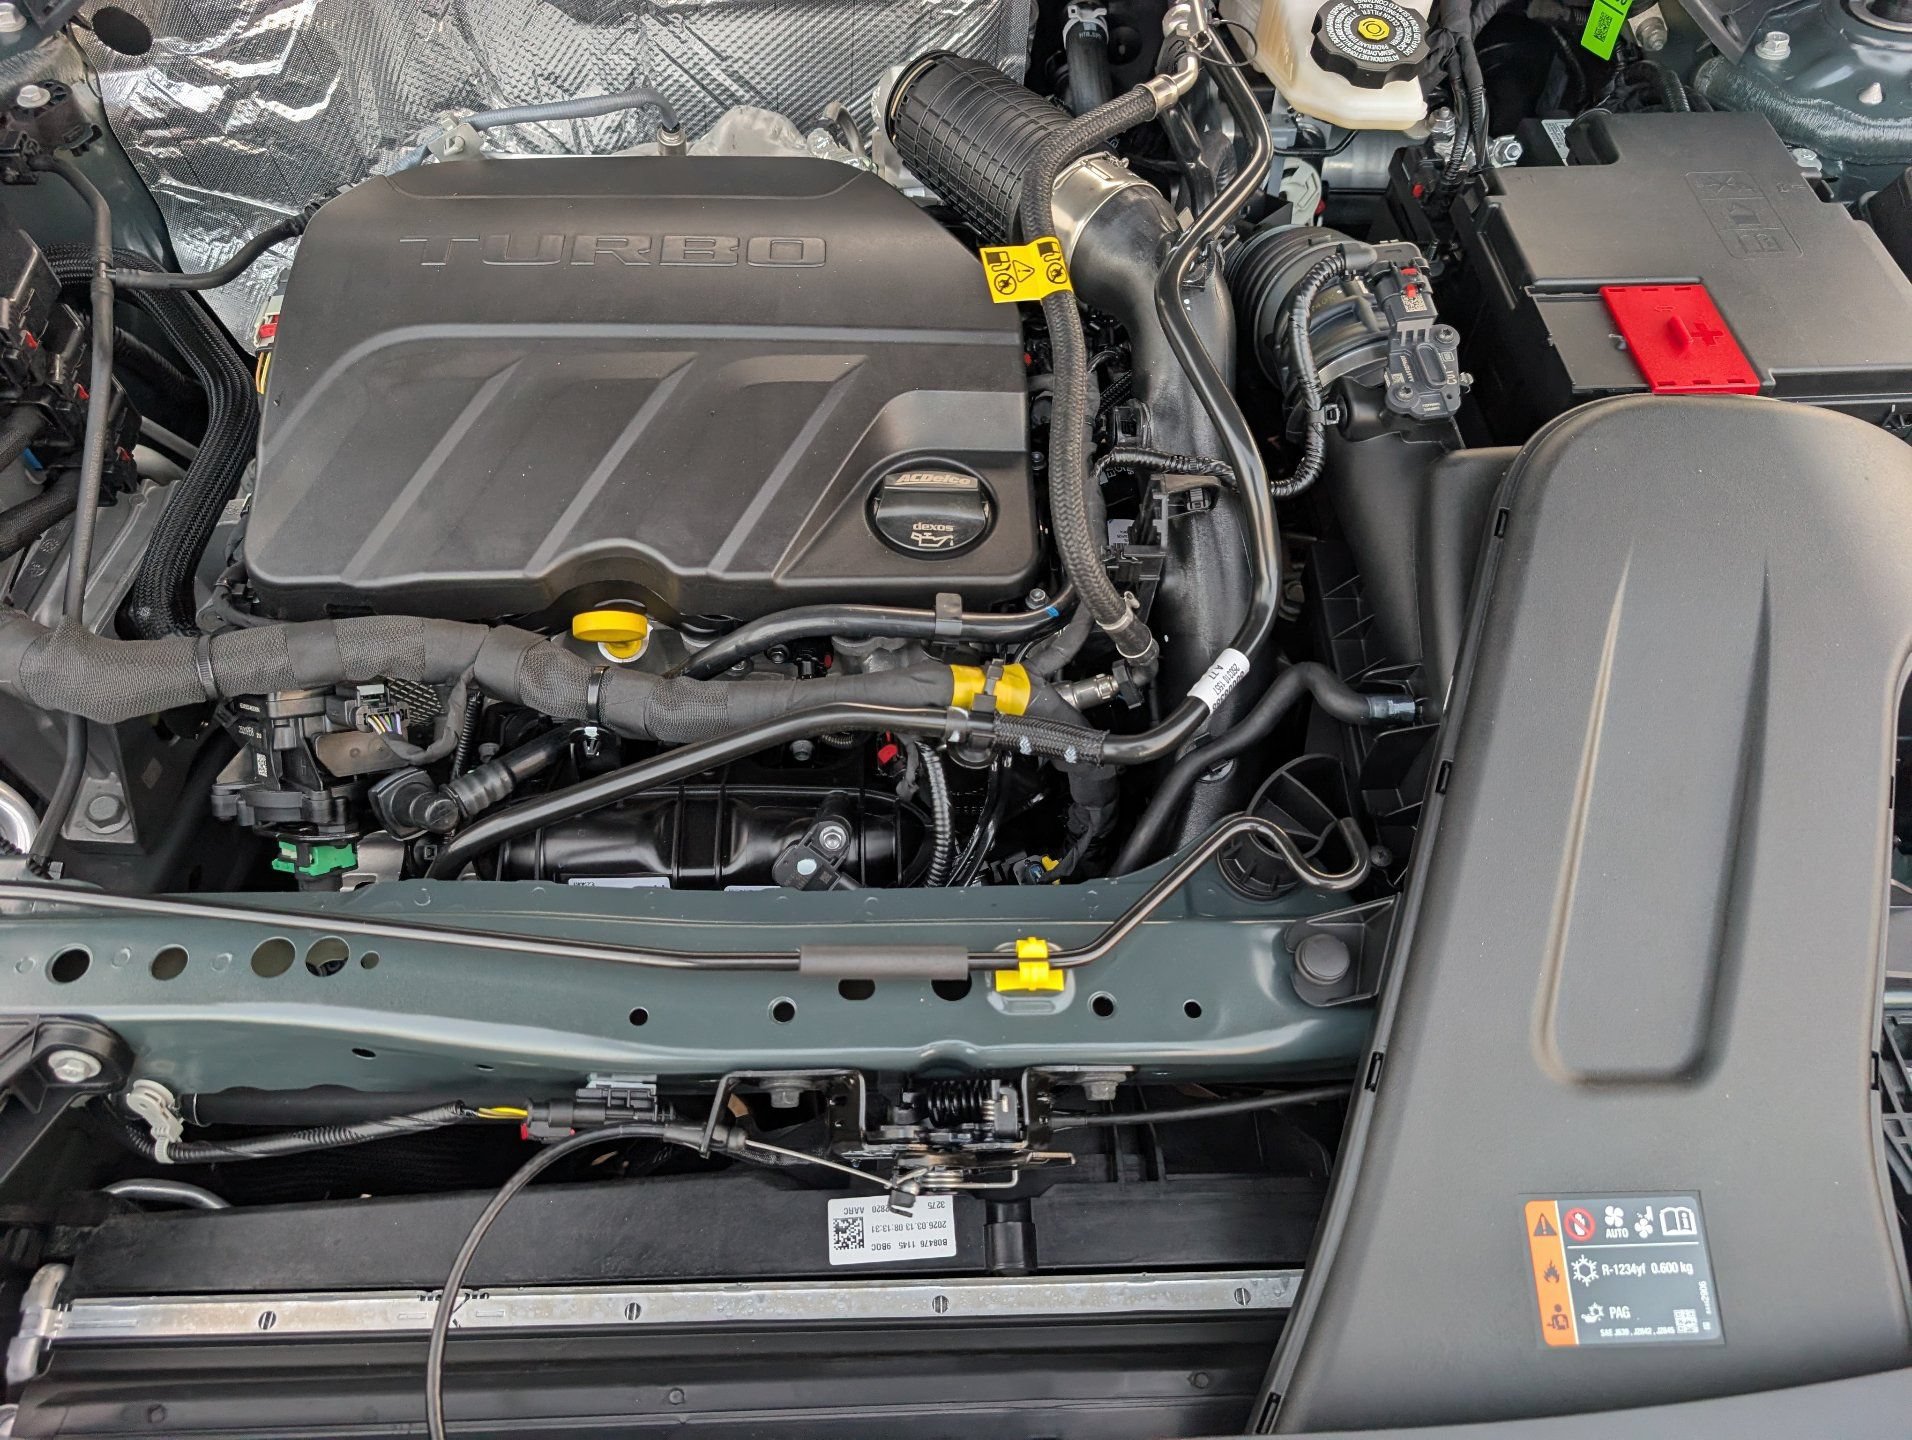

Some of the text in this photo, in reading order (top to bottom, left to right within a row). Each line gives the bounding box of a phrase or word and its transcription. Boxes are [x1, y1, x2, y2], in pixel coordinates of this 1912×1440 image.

[400, 234, 827, 267] TURBO
[895, 473, 971, 485] ACDelco
[912, 522, 955, 531] dexos
[927, 1200, 946, 1210] 3275
[871, 1220, 947, 1233] 2026.03.13 08:13:31
[1606, 1227, 1629, 1238] AUTO
[898, 1241, 915, 1249] 1145
[1601, 1261, 1693, 1277] R-1234yf 0.600 kg
[1609, 1306, 1631, 1319] PAG
